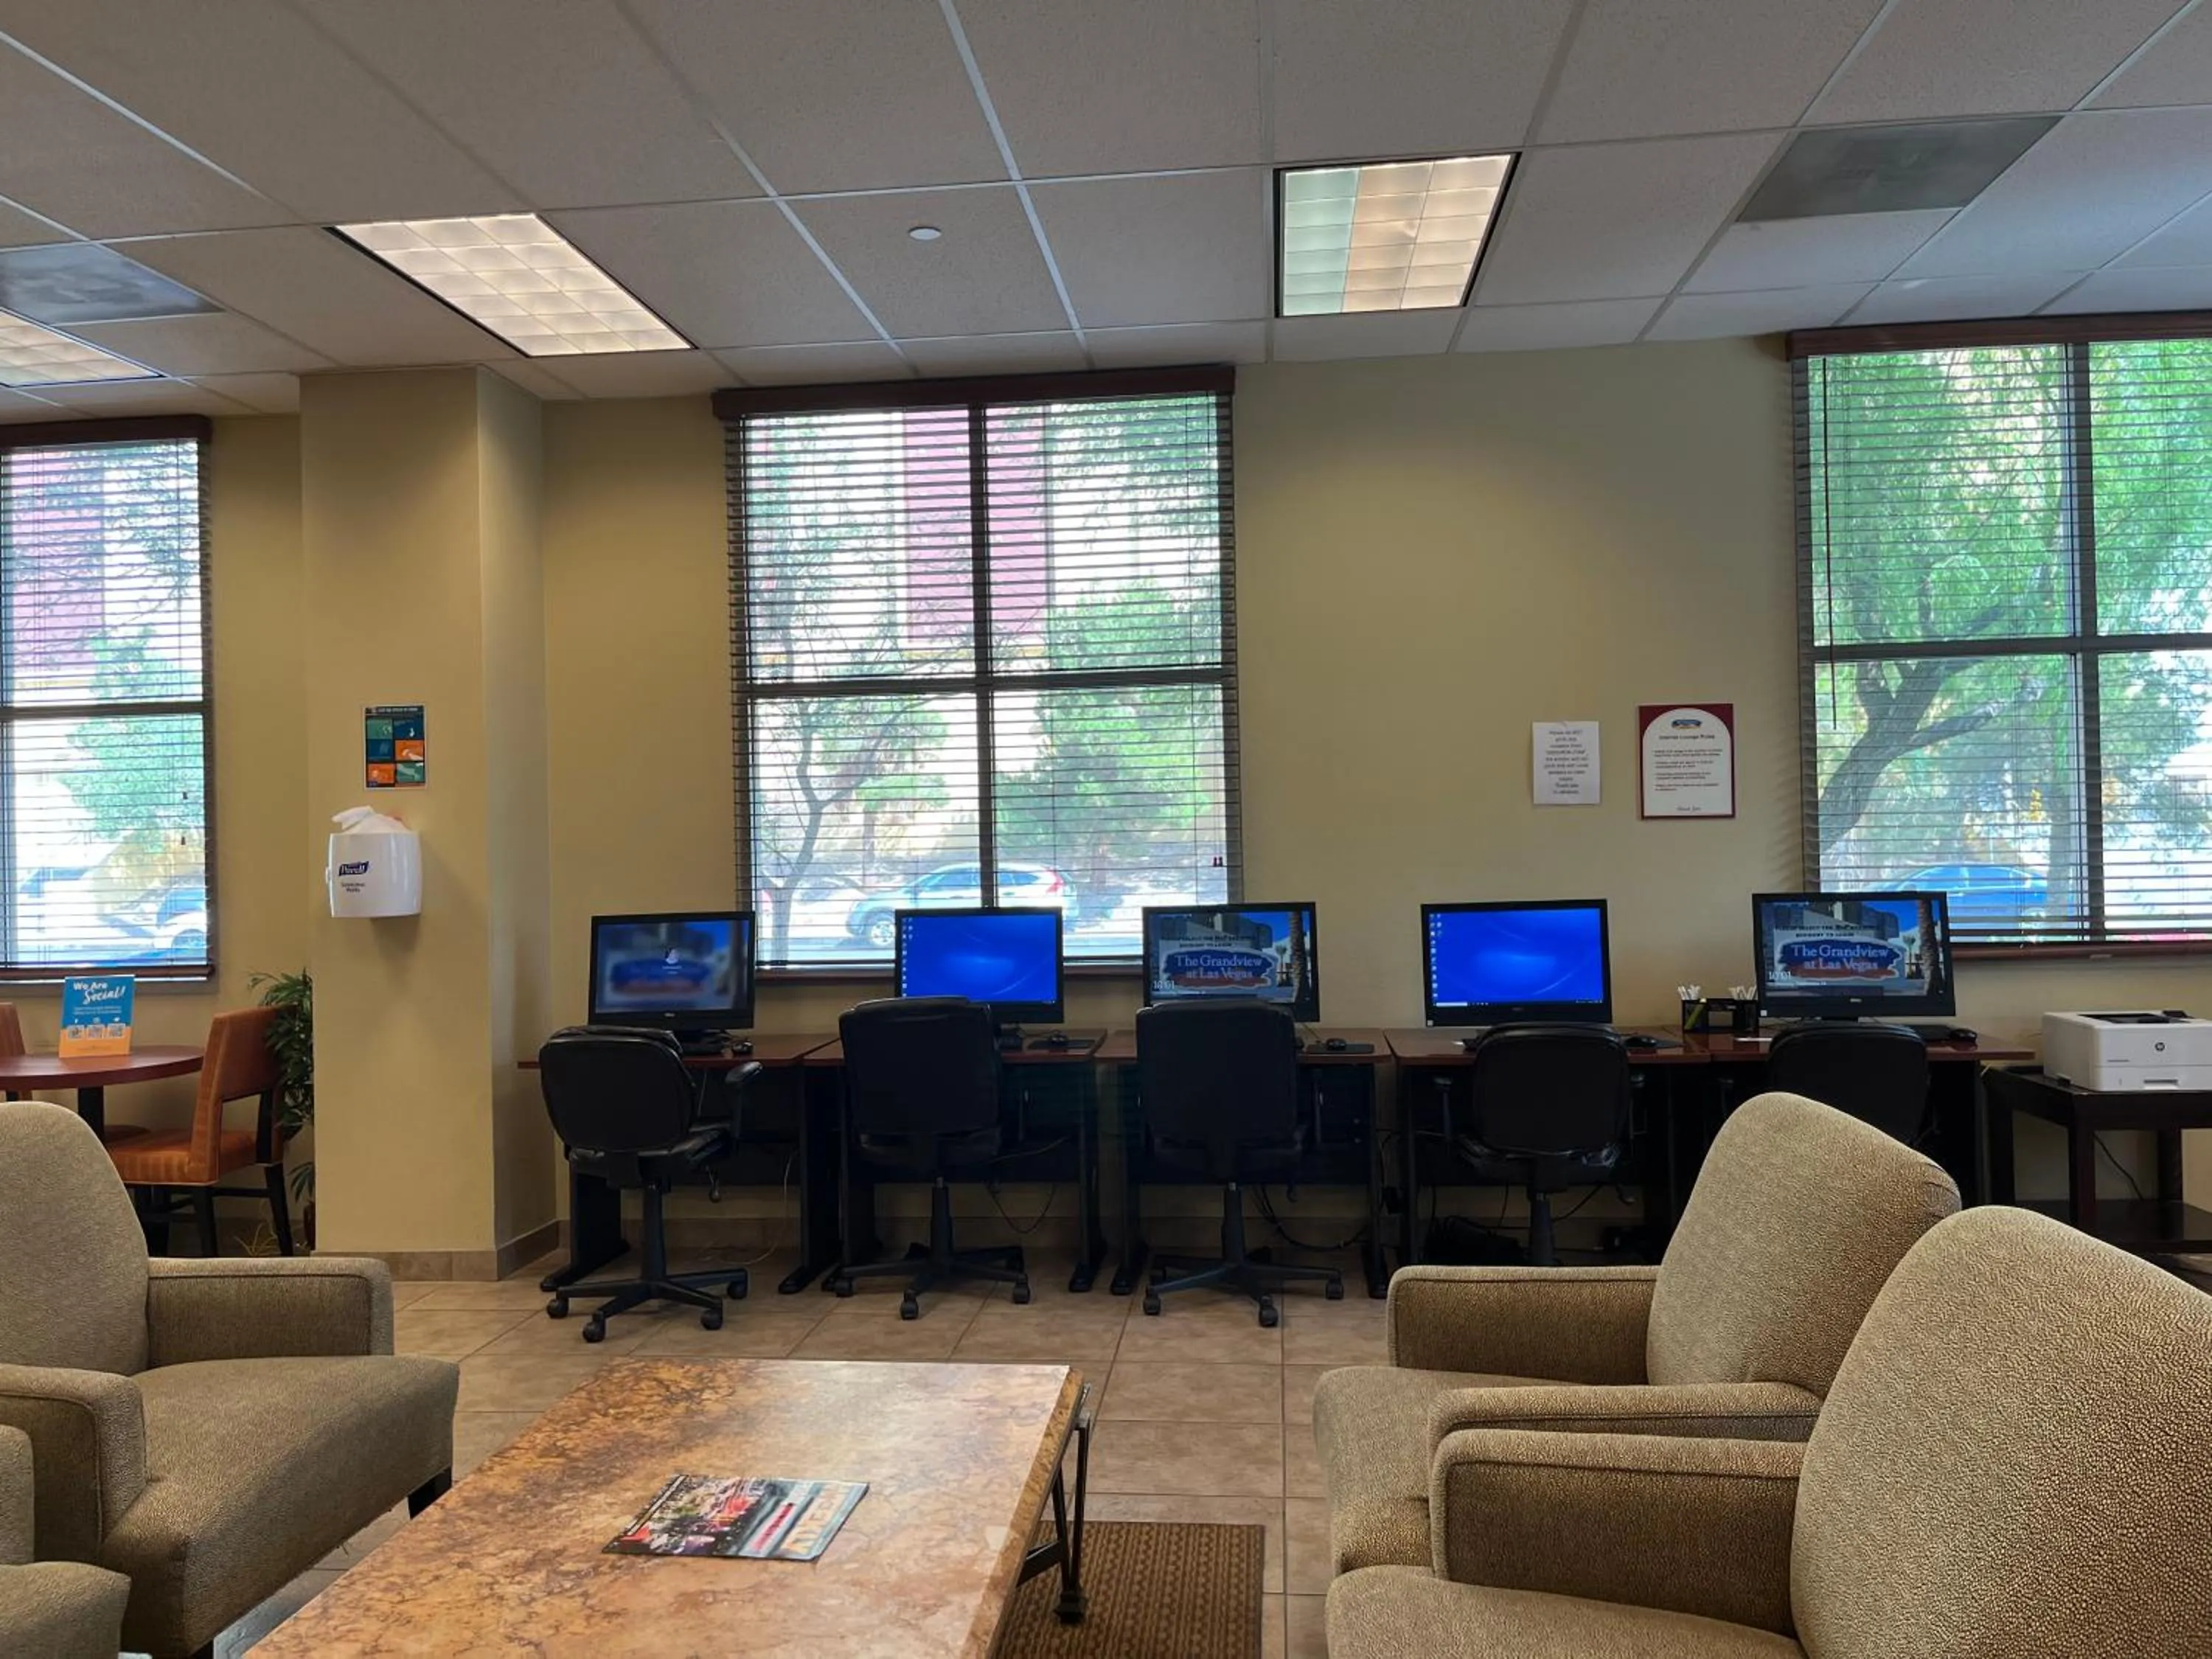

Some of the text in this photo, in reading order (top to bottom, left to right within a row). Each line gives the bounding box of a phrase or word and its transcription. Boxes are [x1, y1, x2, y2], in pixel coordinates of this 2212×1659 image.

[1791, 945, 1888, 957] The Grandview
[1175, 954, 1262, 967] The Grandview
[1804, 958, 1879, 973] at Las Vegas
[1199, 967, 1219, 978] Las
[1220, 967, 1253, 981] Vegas
[73, 981, 108, 991] We Are
[83, 985, 126, 1004] Social!
